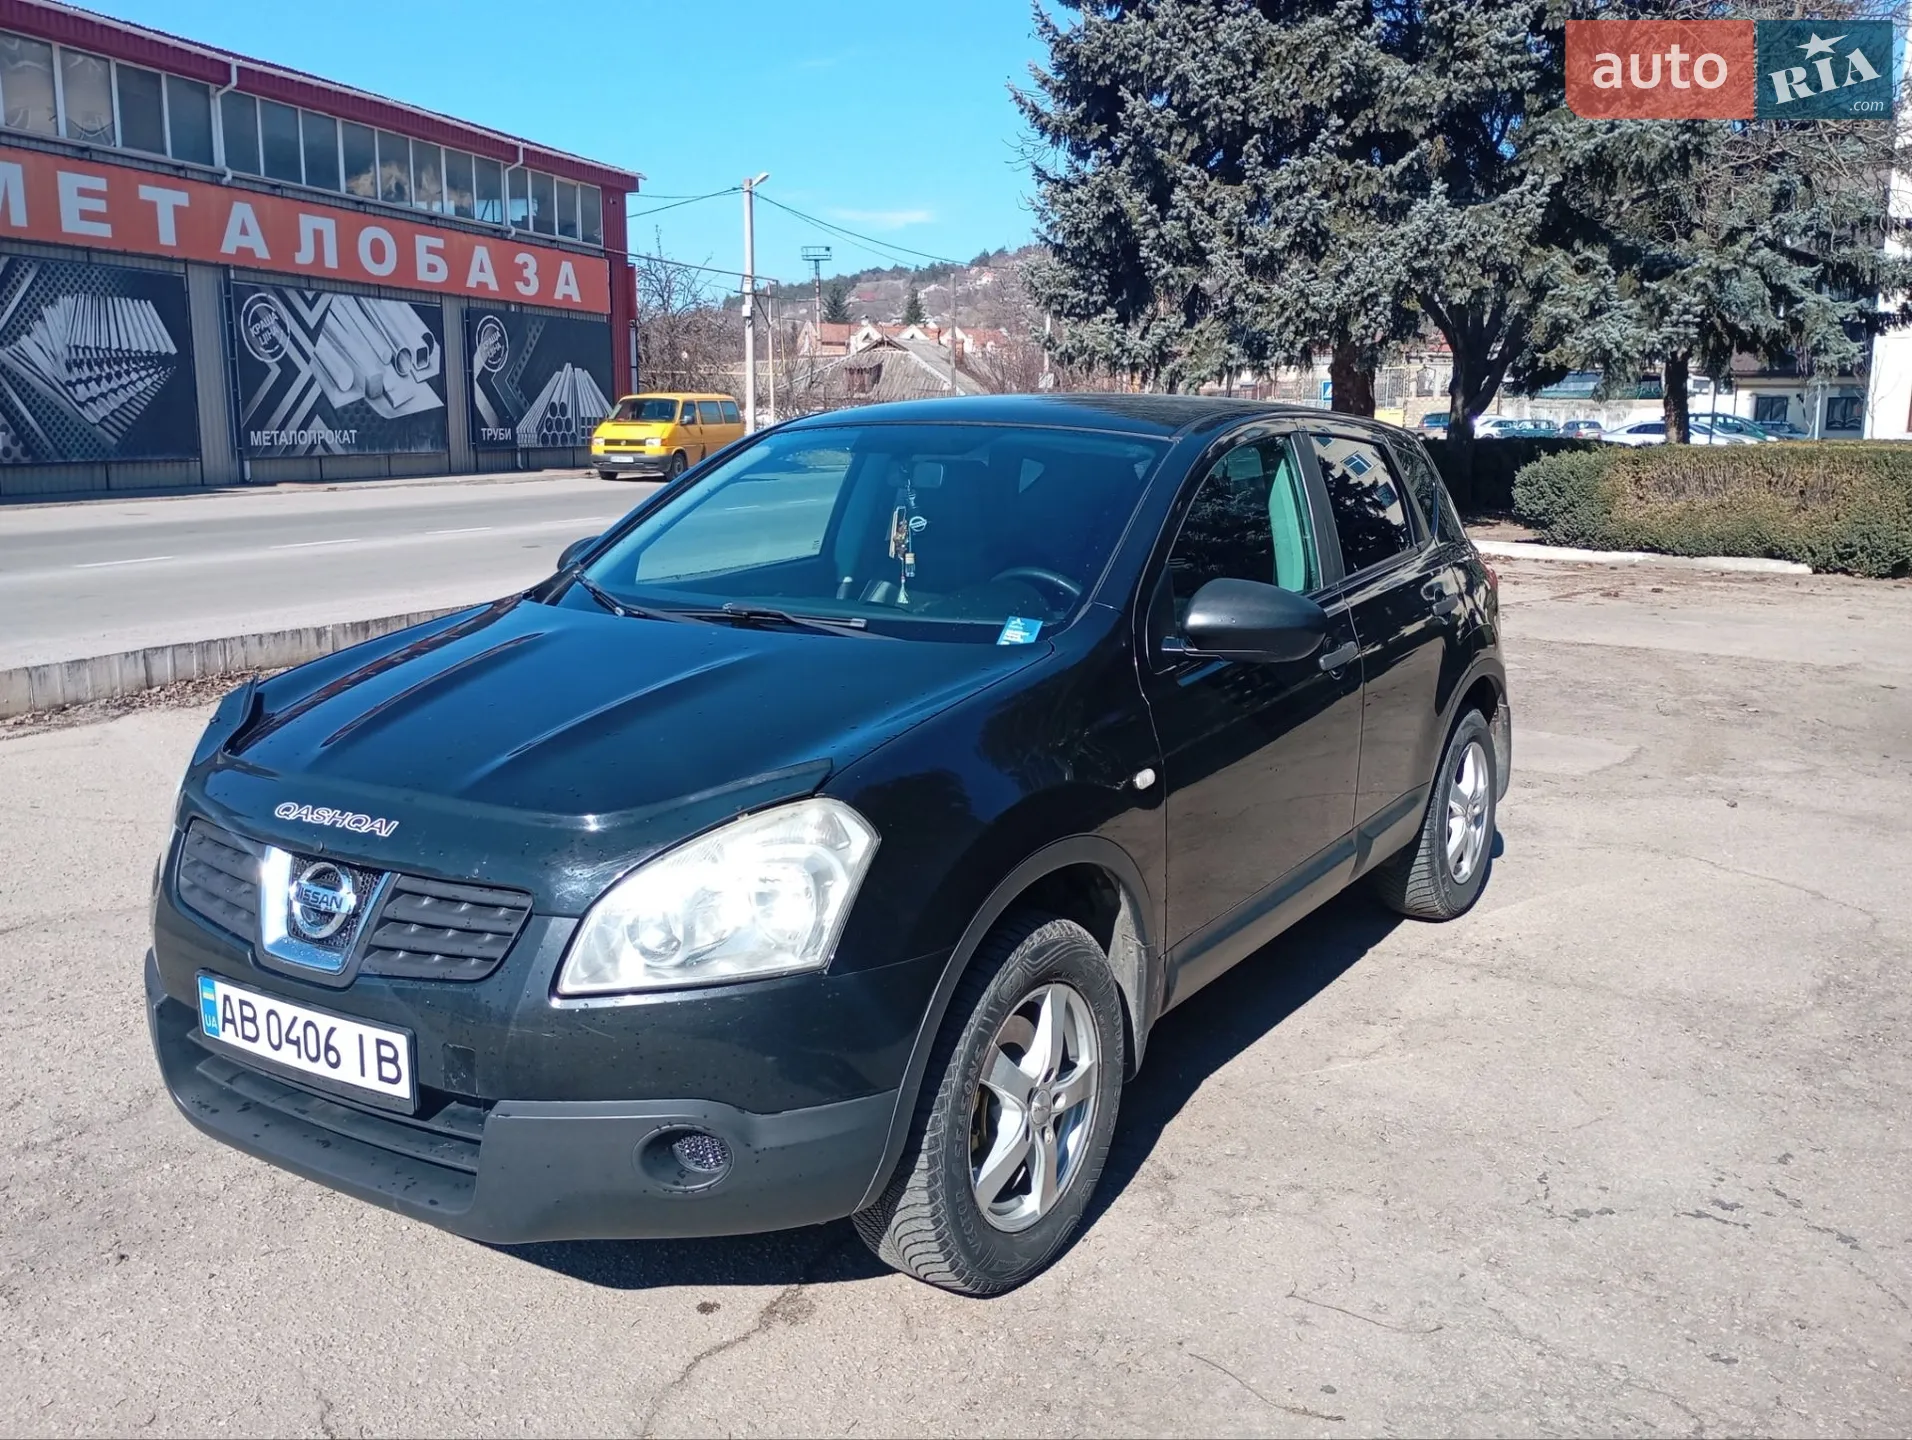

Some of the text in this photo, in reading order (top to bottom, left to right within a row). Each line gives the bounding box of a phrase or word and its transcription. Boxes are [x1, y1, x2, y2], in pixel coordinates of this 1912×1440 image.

[250, 430, 358, 446] МЕТАЛОПРОКАТ
[481, 428, 512, 440] ТРУБИ
[274, 802, 399, 837] QASHQAI
[205, 1013, 218, 1030] UA
